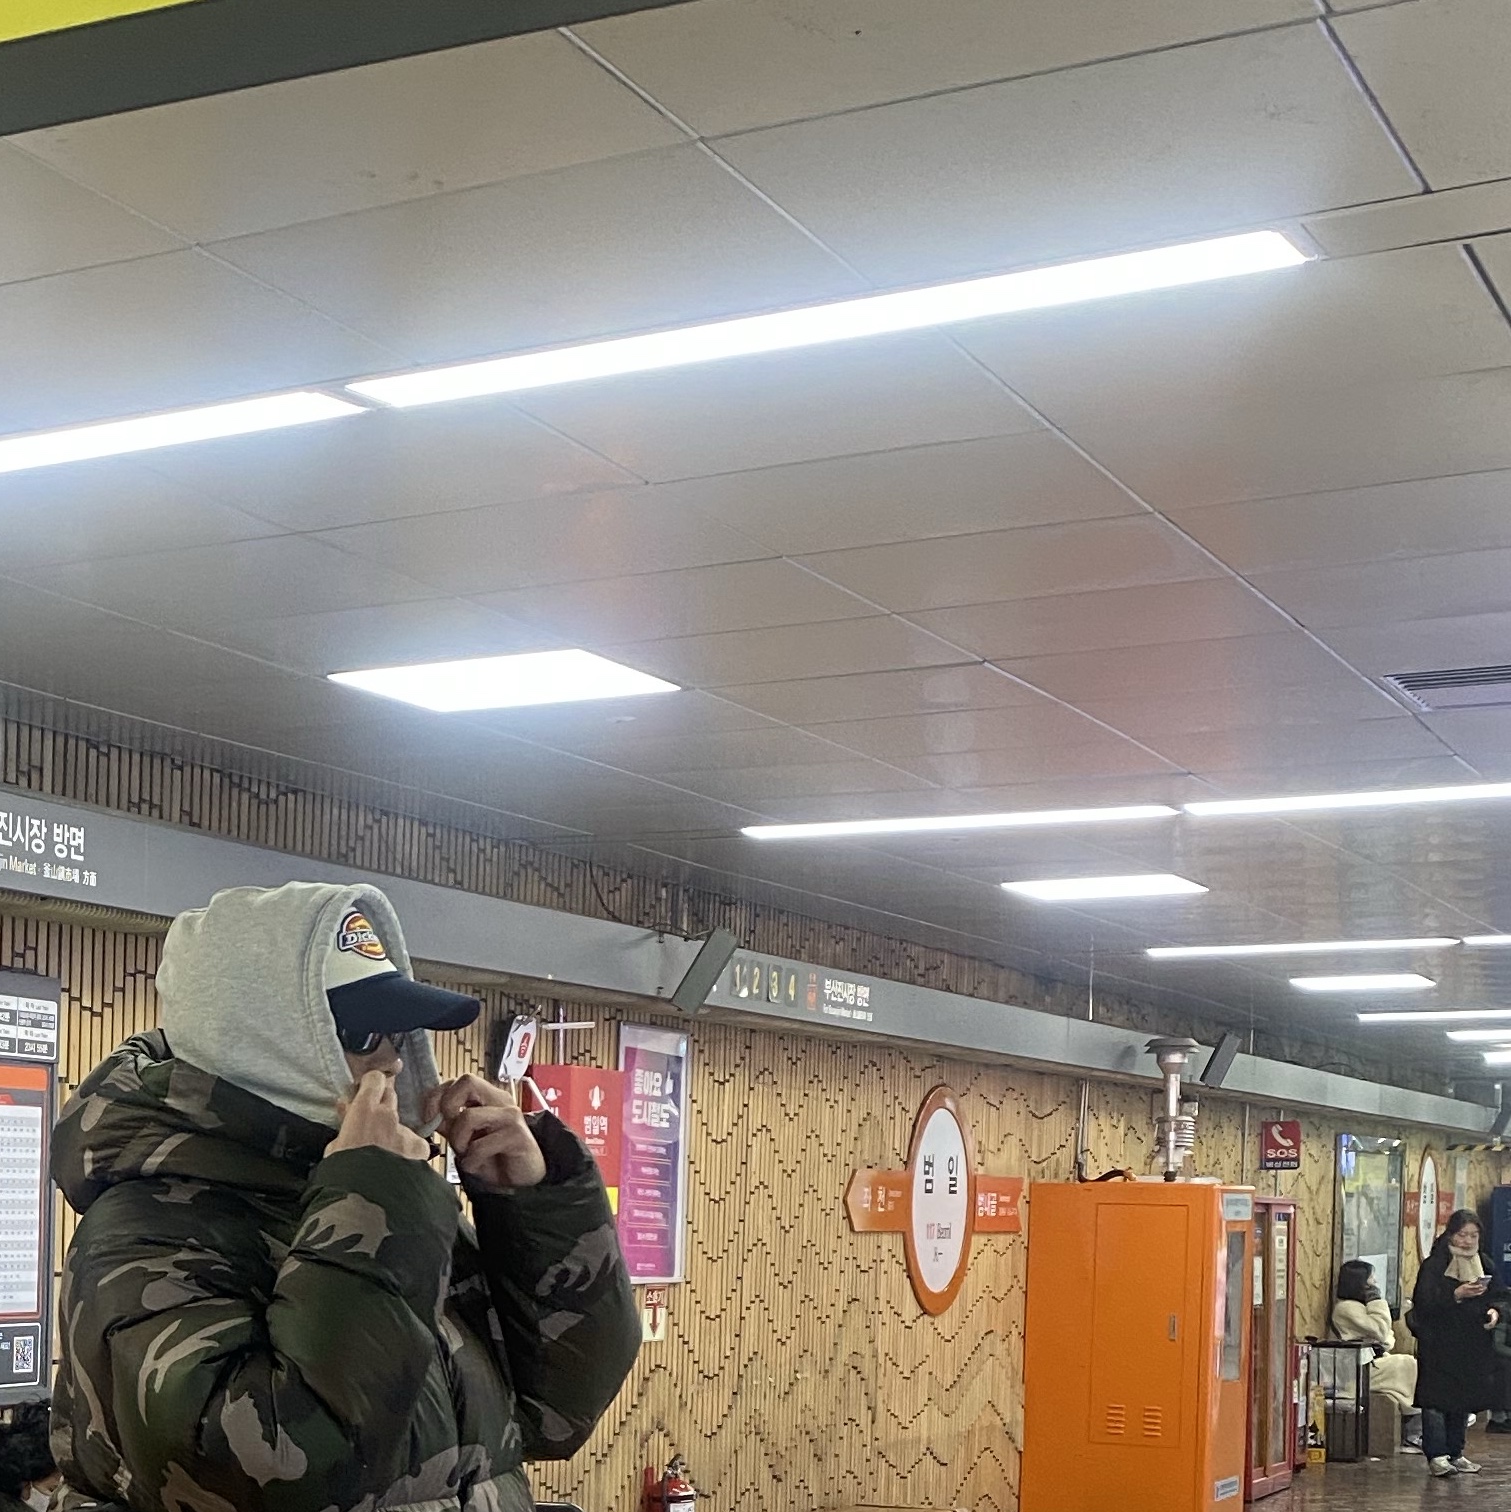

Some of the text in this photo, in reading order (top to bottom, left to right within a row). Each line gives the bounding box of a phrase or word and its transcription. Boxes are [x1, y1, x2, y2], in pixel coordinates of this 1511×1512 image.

[53, 823, 84, 861] 방면
[9, 855, 37, 876] Market
[753, 967, 760, 994] 2
[771, 971, 778, 997] 3
[788, 974, 795, 1001] 4
[1267, 1148, 1298, 1158] SOS
